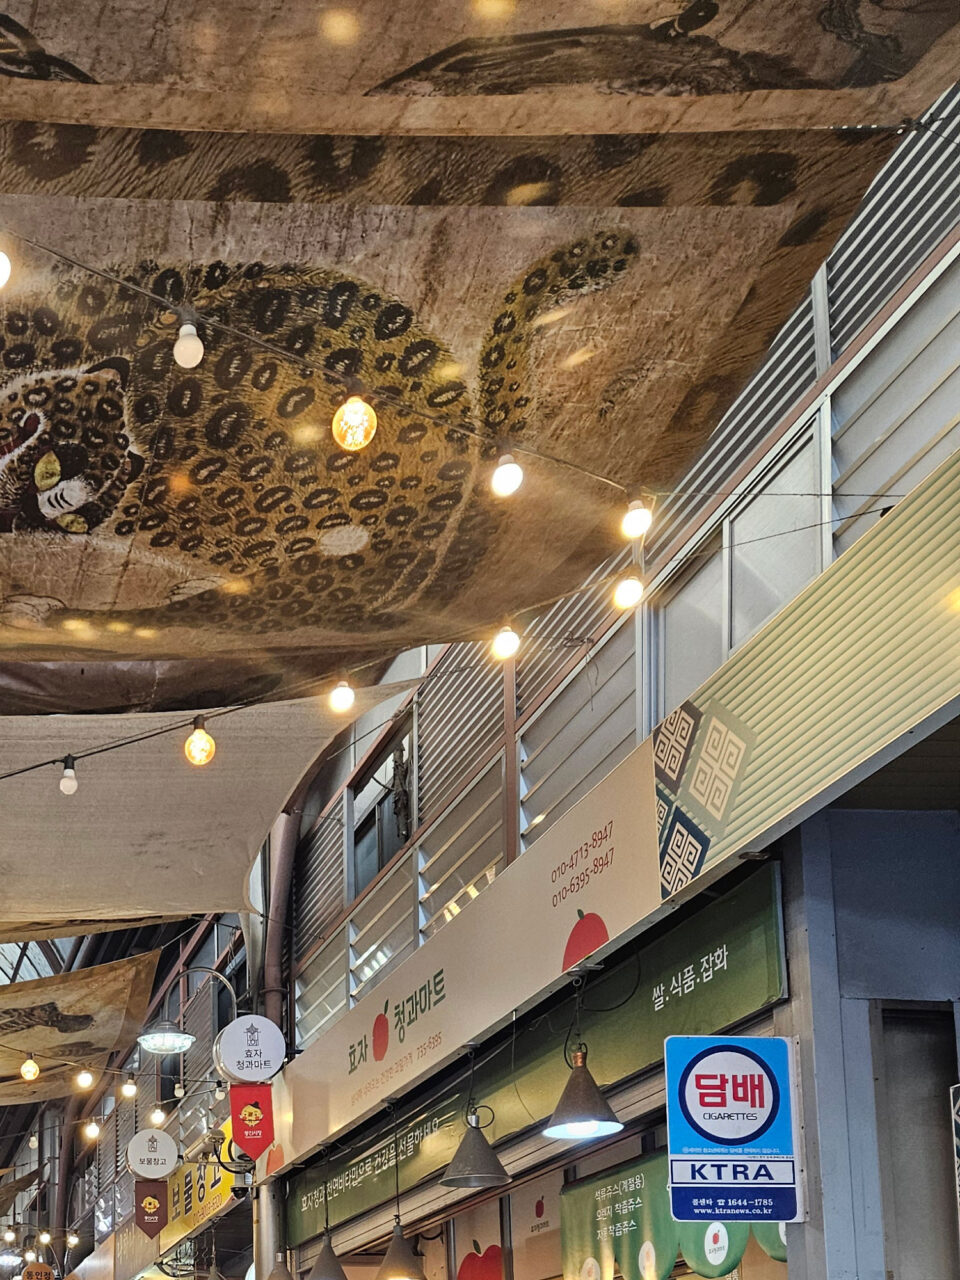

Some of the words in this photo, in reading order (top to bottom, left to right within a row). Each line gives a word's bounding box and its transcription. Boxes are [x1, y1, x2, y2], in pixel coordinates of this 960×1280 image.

[551, 820, 614, 883] 010-4713-8947
[552, 848, 615, 908] 010-6395-8947
[348, 1034, 368, 1075] 효자
[394, 967, 446, 1044] 청과마트
[244, 1049, 262, 1059] 효자
[236, 1059, 272, 1071] 청과마트
[695, 1073, 765, 1109] 담배
[702, 1112, 758, 1121] CIGARETTES
[138, 1157, 167, 1167] 보물창고
[690, 1163, 775, 1181] KTRA
[614, 1197, 643, 1215] 착즙쥬스
[693, 1207, 773, 1215] www.ktranews.co.kr
[728, 1198, 773, 1206] 1644-1785
[608, 1219, 637, 1237] 착즙쥬스
